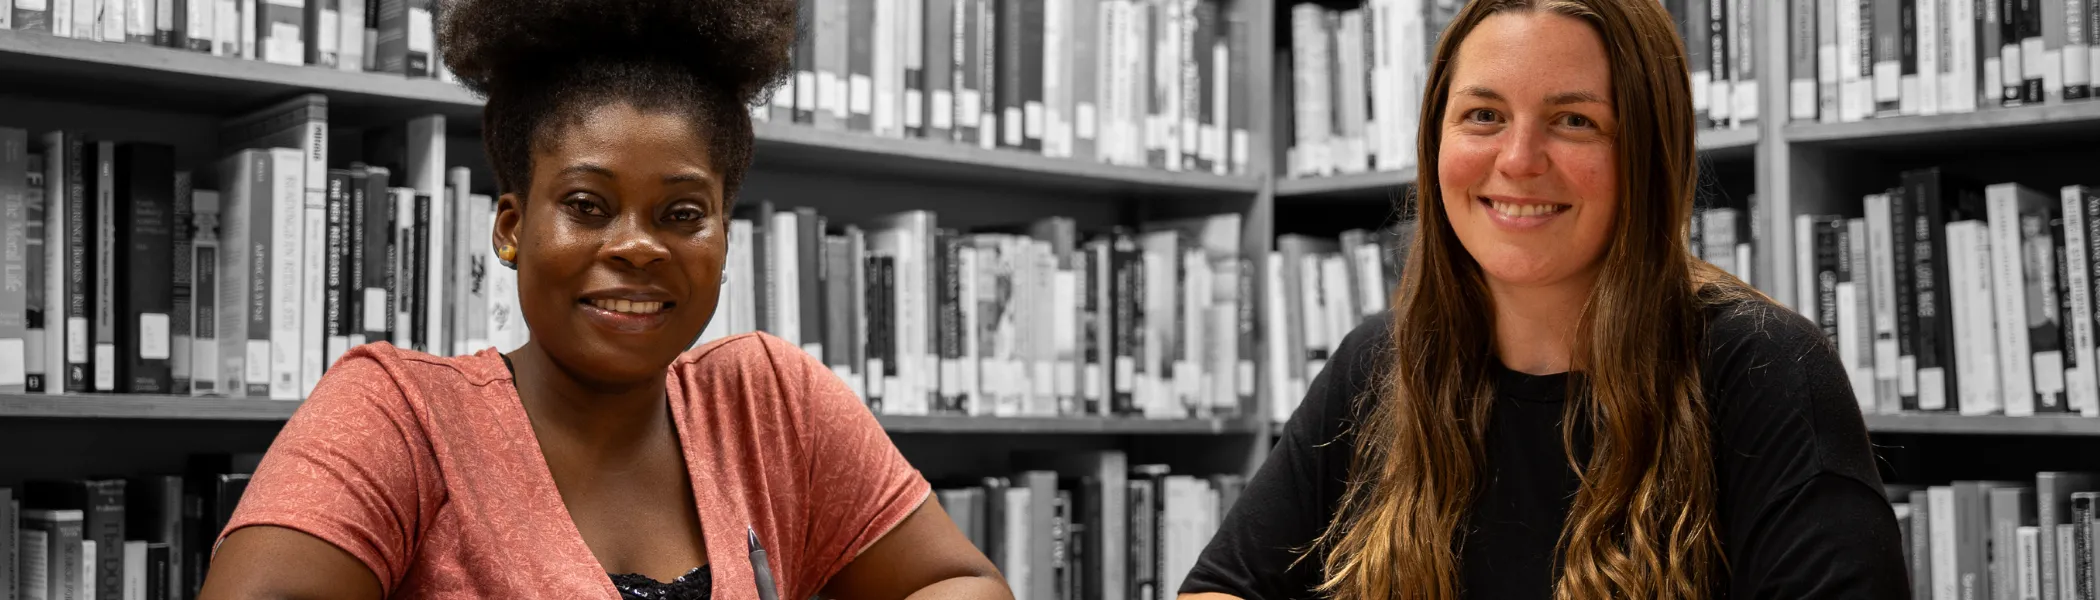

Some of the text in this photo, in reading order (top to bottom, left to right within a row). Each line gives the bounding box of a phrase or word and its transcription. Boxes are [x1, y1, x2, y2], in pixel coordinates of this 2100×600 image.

[331, 179, 341, 200] THE
[330, 201, 341, 223] NEW
[5, 193, 22, 292] The Moral Life
[329, 226, 340, 286] RELIGIOUS
[72, 246, 84, 283] BOOKS
